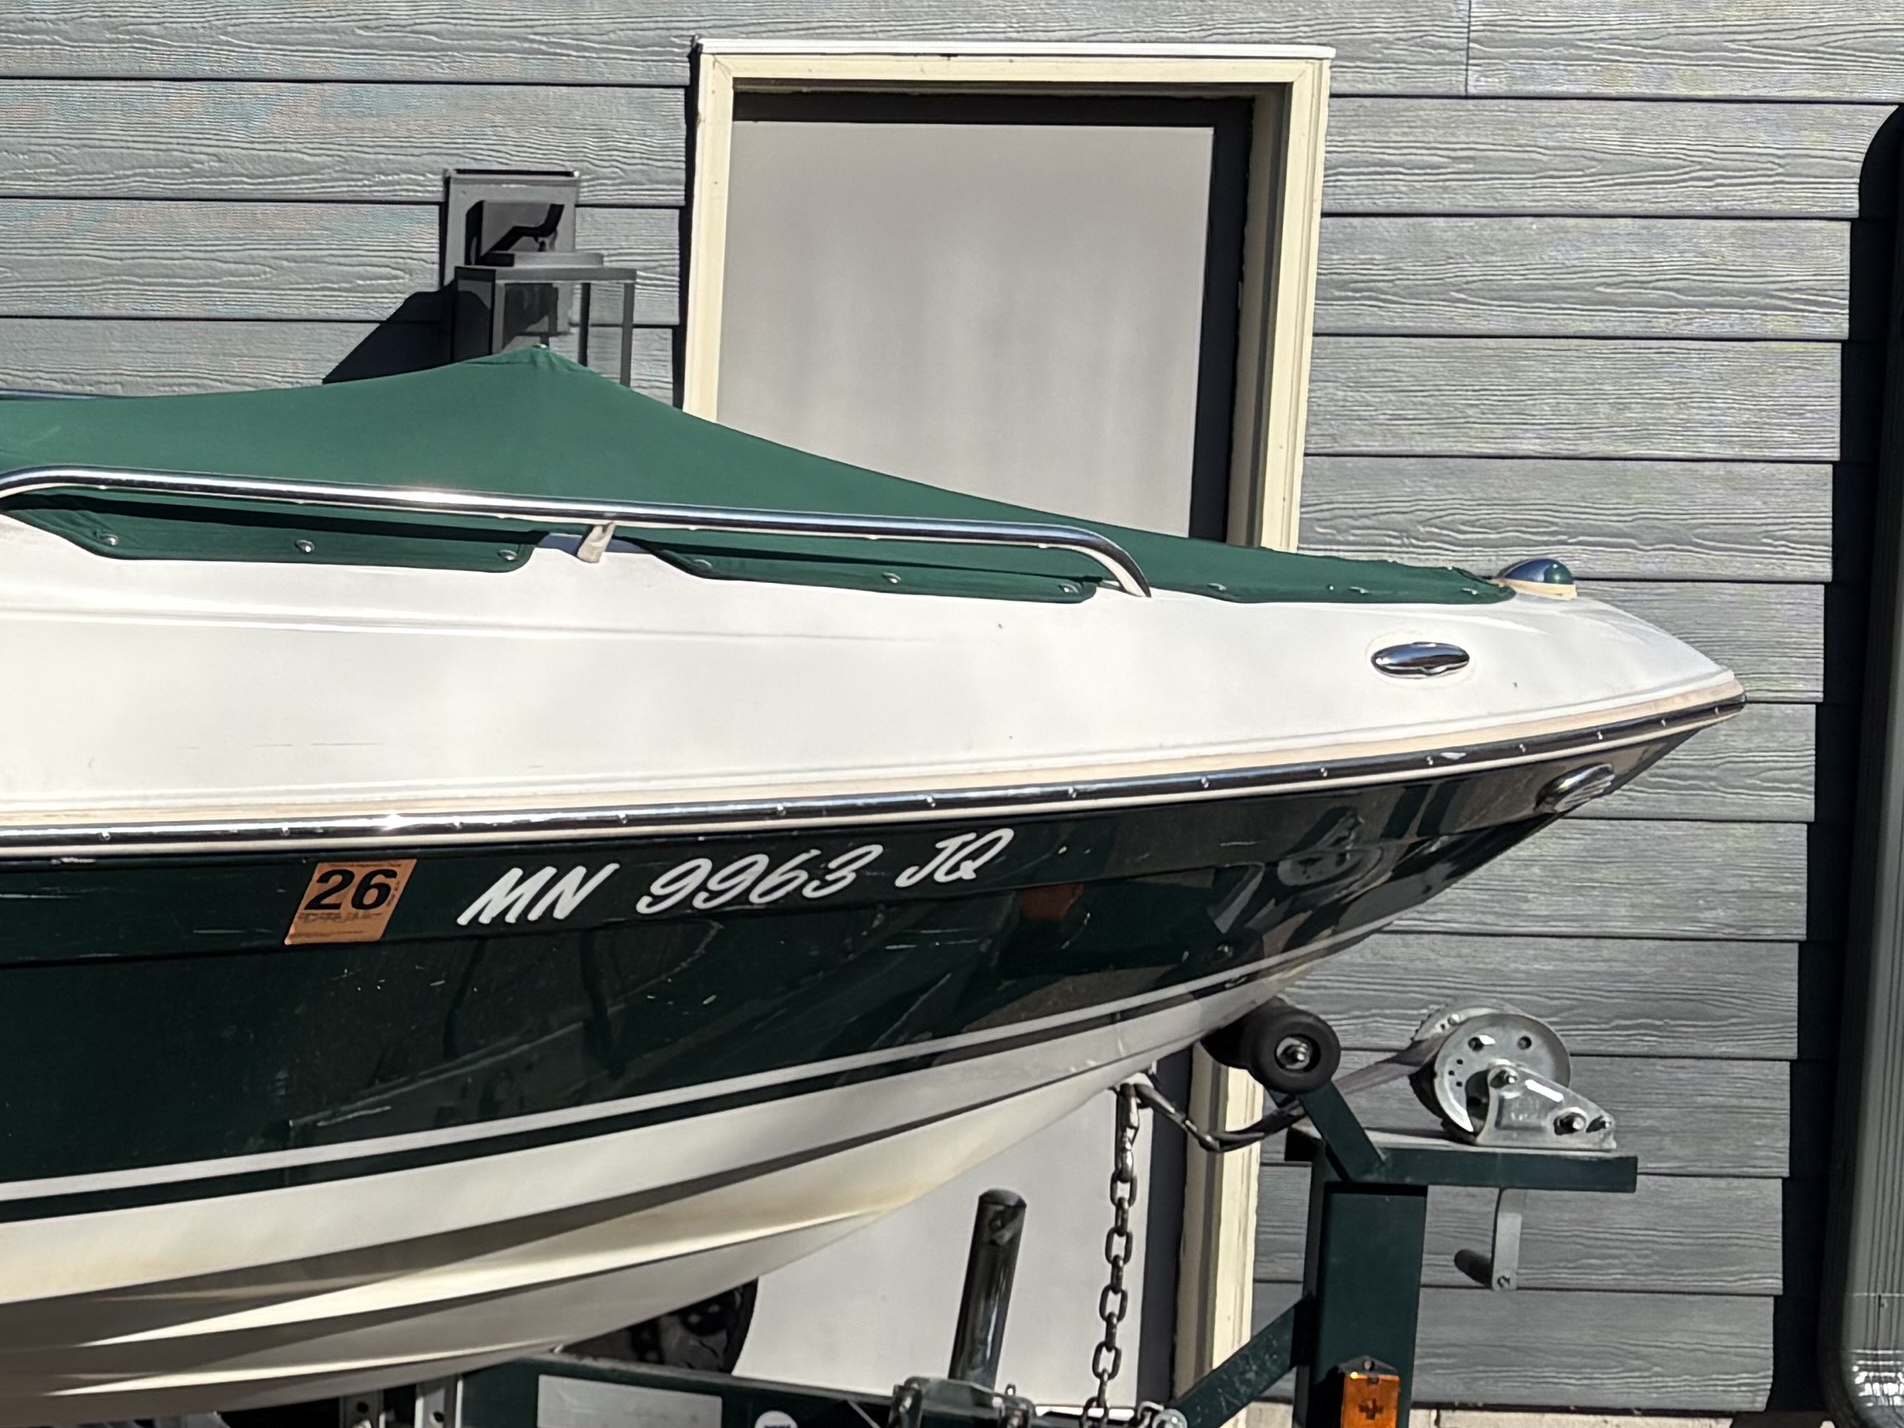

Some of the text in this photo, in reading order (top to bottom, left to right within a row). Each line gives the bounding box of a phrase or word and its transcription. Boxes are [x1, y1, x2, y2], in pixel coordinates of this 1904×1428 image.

[303, 868, 398, 910] 26
[456, 862, 620, 926] MN
[635, 844, 884, 914] 9963
[895, 828, 1014, 887] JQ
